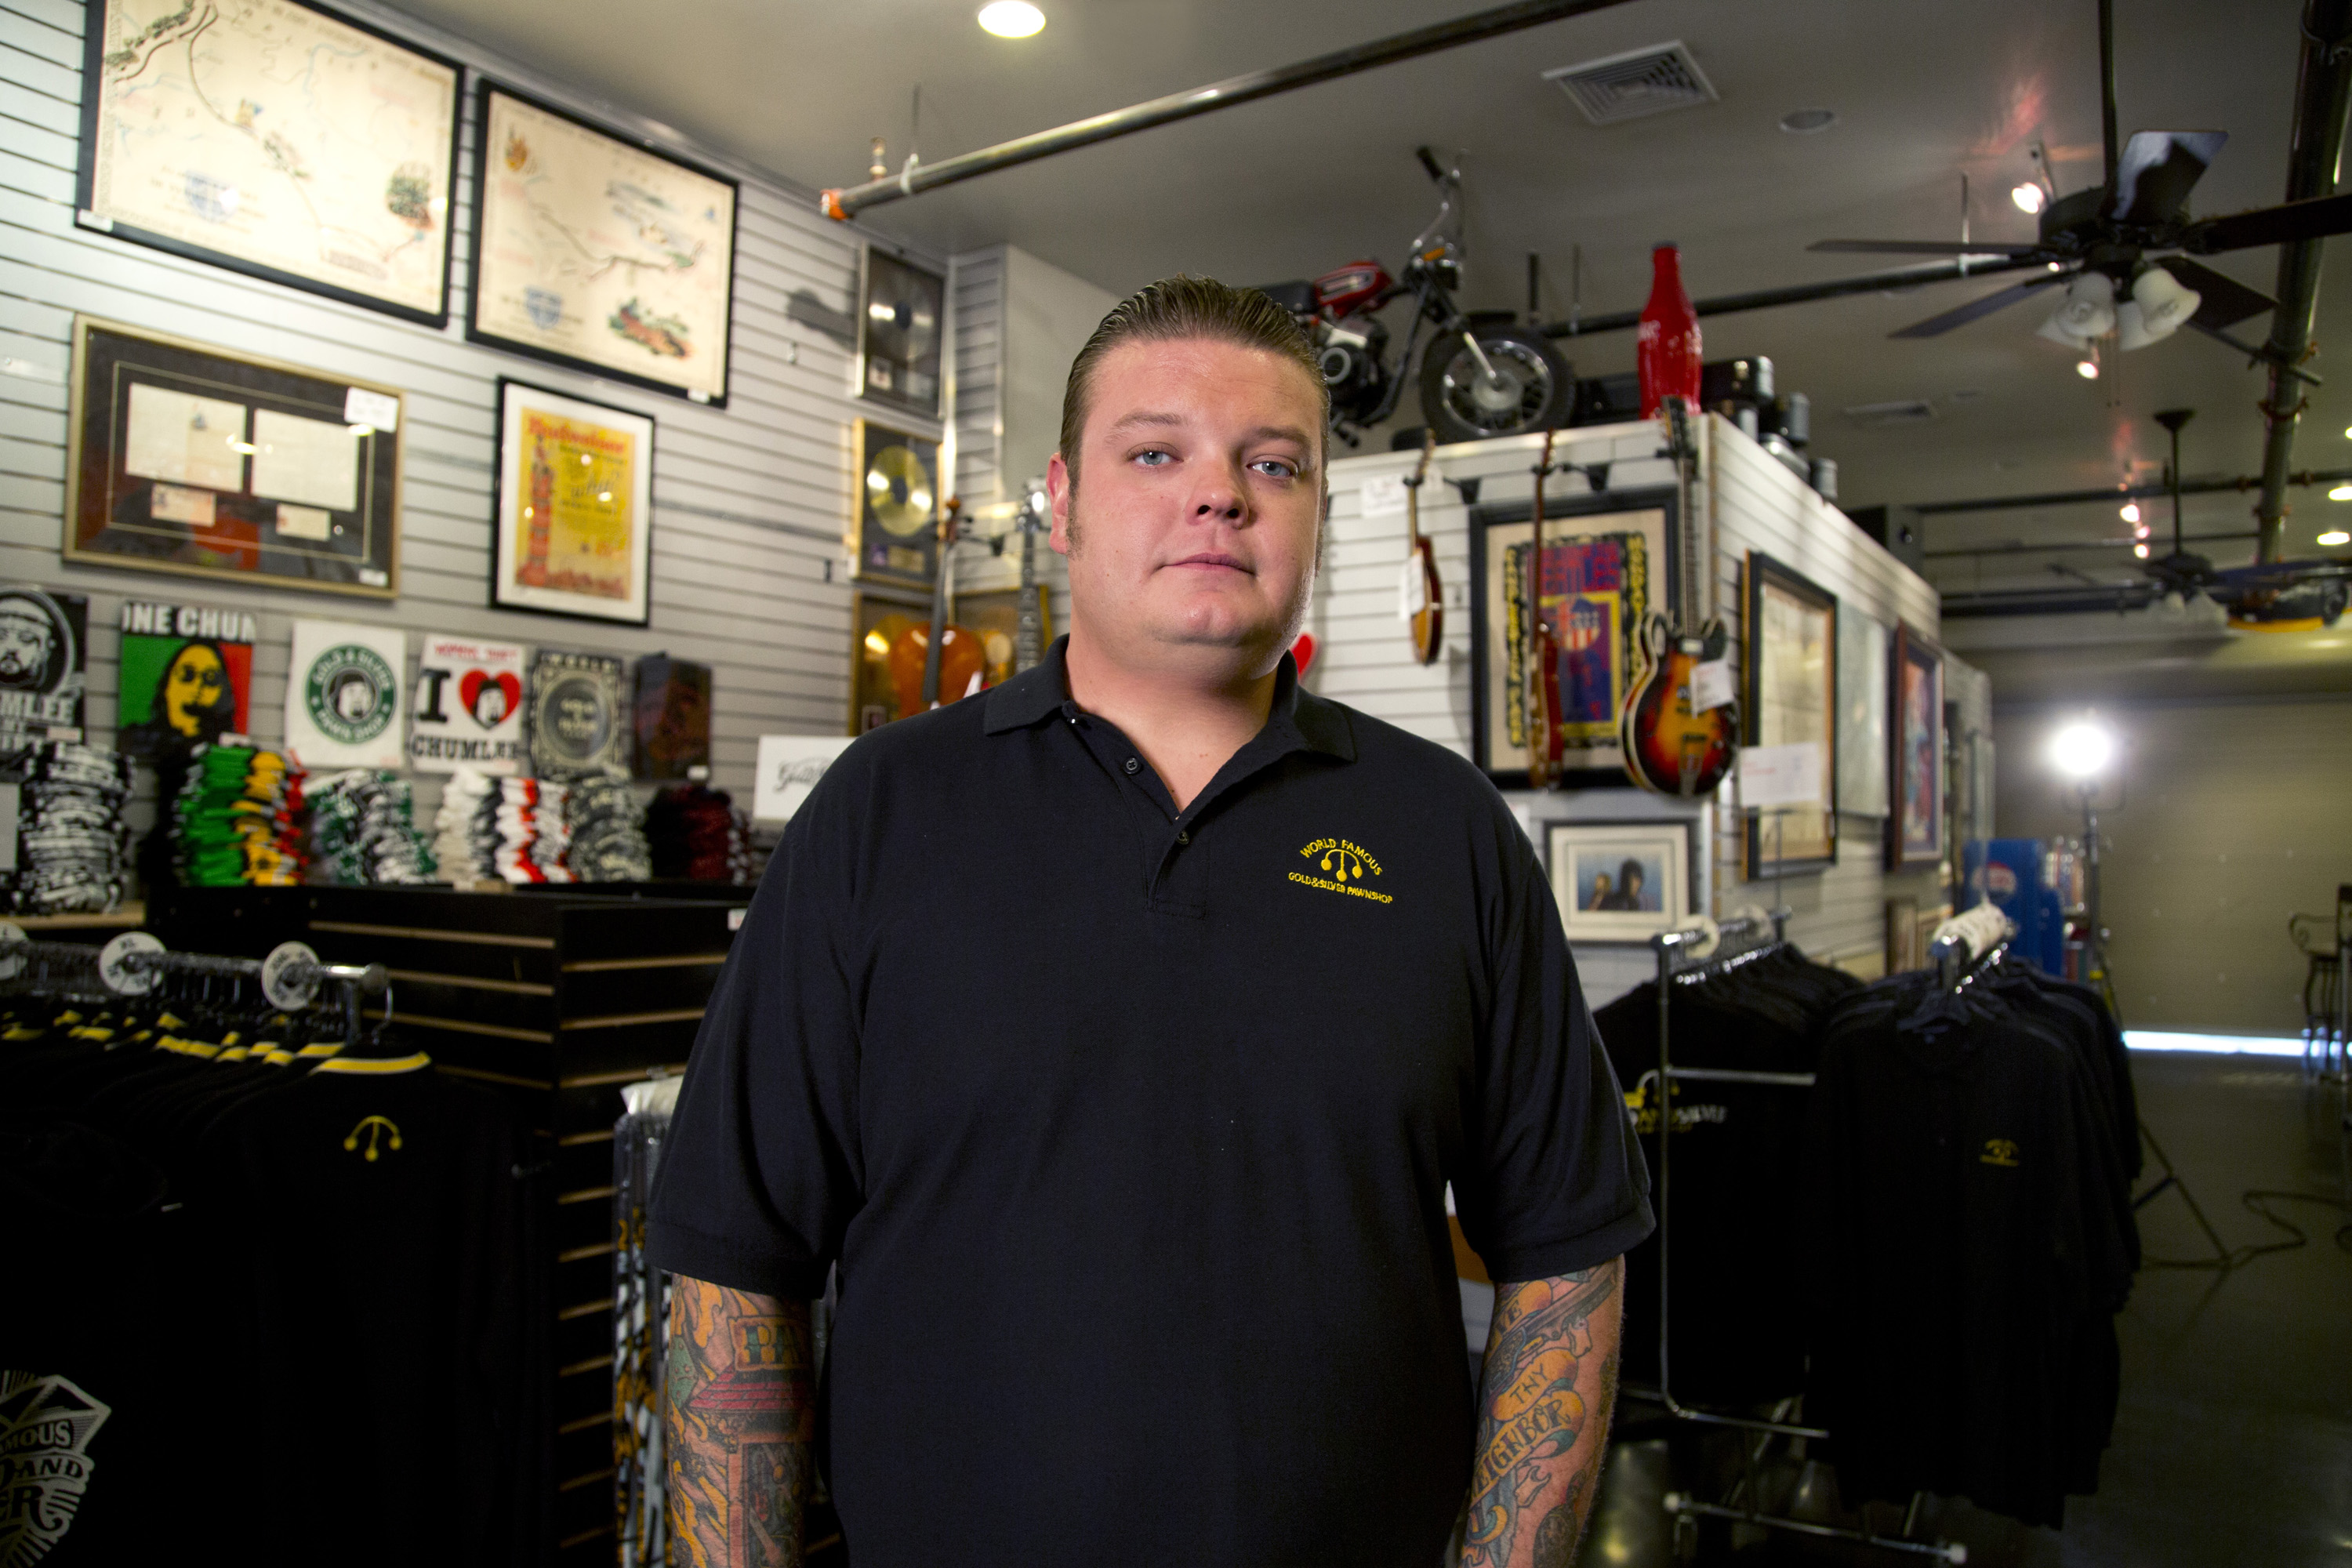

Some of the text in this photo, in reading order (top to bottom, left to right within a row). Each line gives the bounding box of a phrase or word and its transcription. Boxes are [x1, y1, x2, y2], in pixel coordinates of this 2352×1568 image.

[416, 667, 452, 724] I
[1300, 838, 1383, 876] WORLD FAMOUS
[1510, 1363, 1548, 1404] THY
[1473, 1399, 1572, 1497] EIGHBOR
